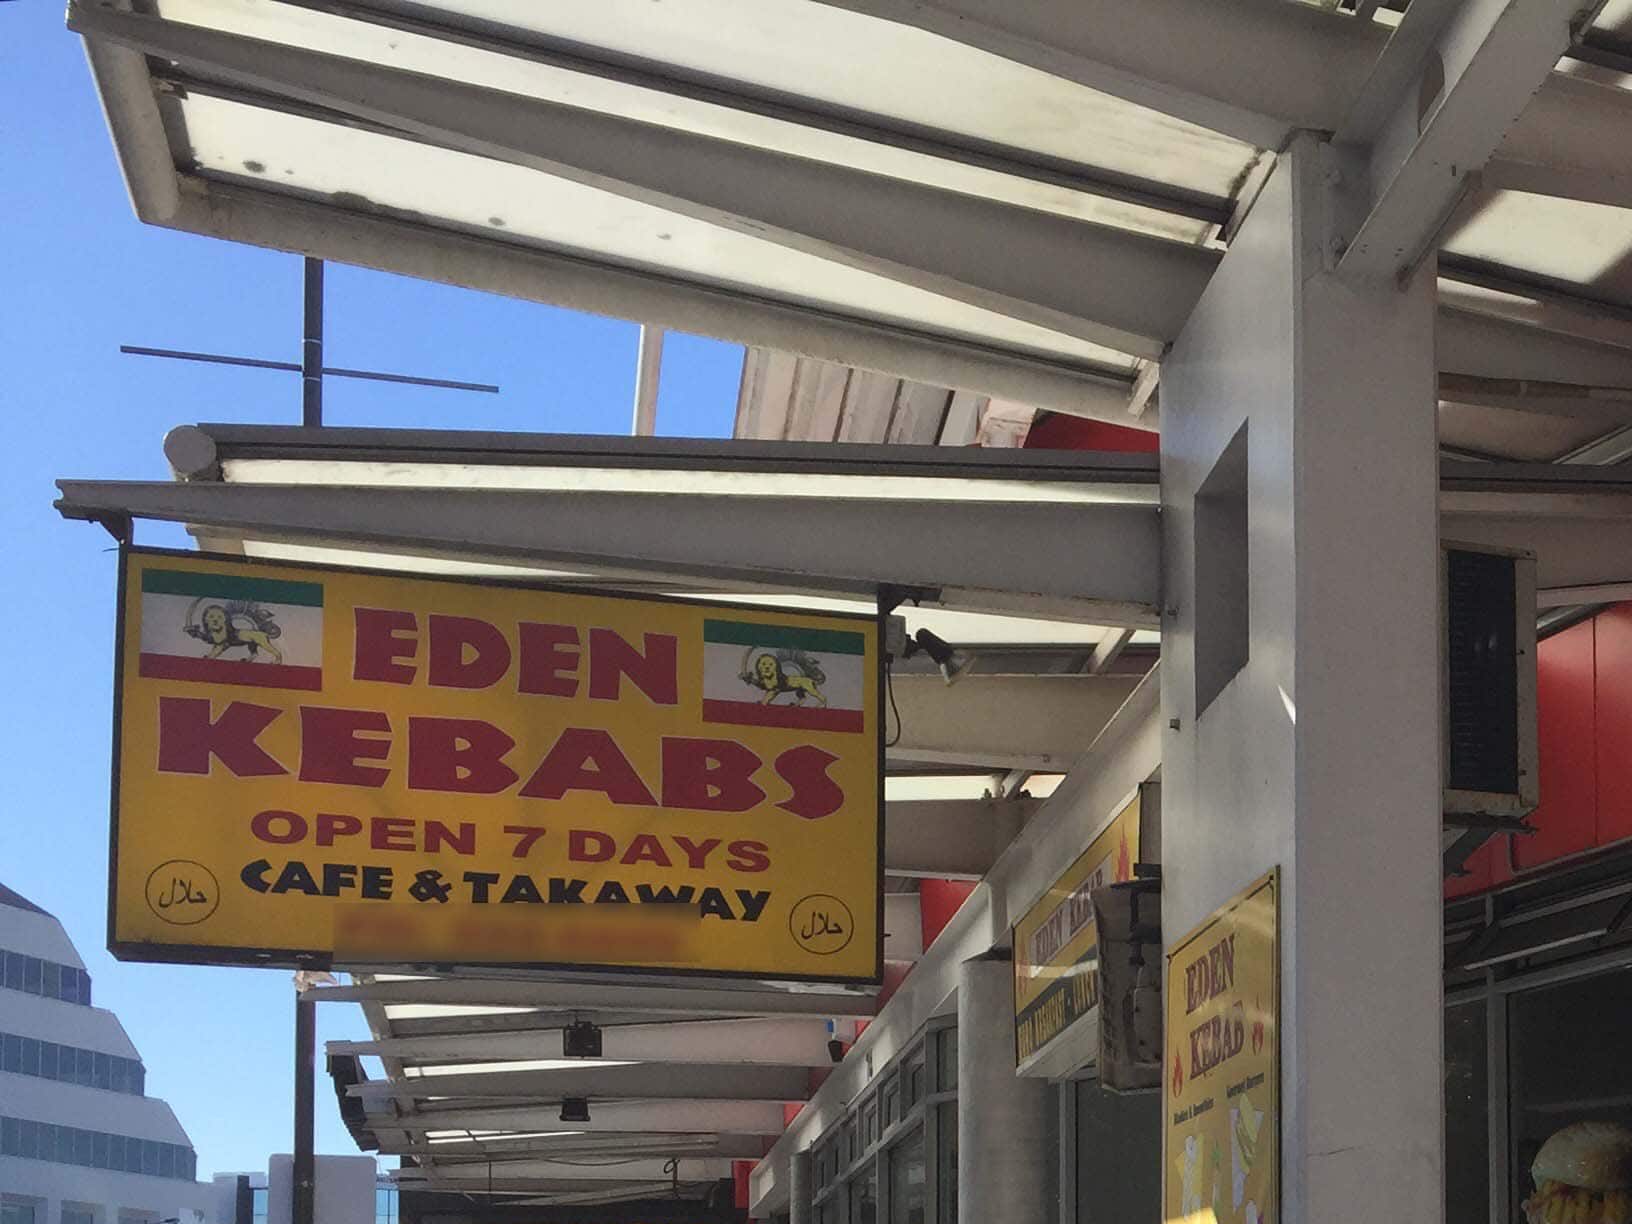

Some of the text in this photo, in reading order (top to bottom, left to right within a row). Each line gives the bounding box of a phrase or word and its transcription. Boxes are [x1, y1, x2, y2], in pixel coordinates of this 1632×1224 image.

[352, 606, 679, 706] EDEN
[157, 695, 846, 820] KEBABS
[240, 858, 394, 900] CAFE
[408, 869, 452, 903] &
[250, 810, 772, 873] OPEN 7 DAYS
[1035, 905, 1063, 968] EDEN
[1185, 932, 1236, 1015] EDEN
[1189, 1001, 1245, 1081] KEBAB
